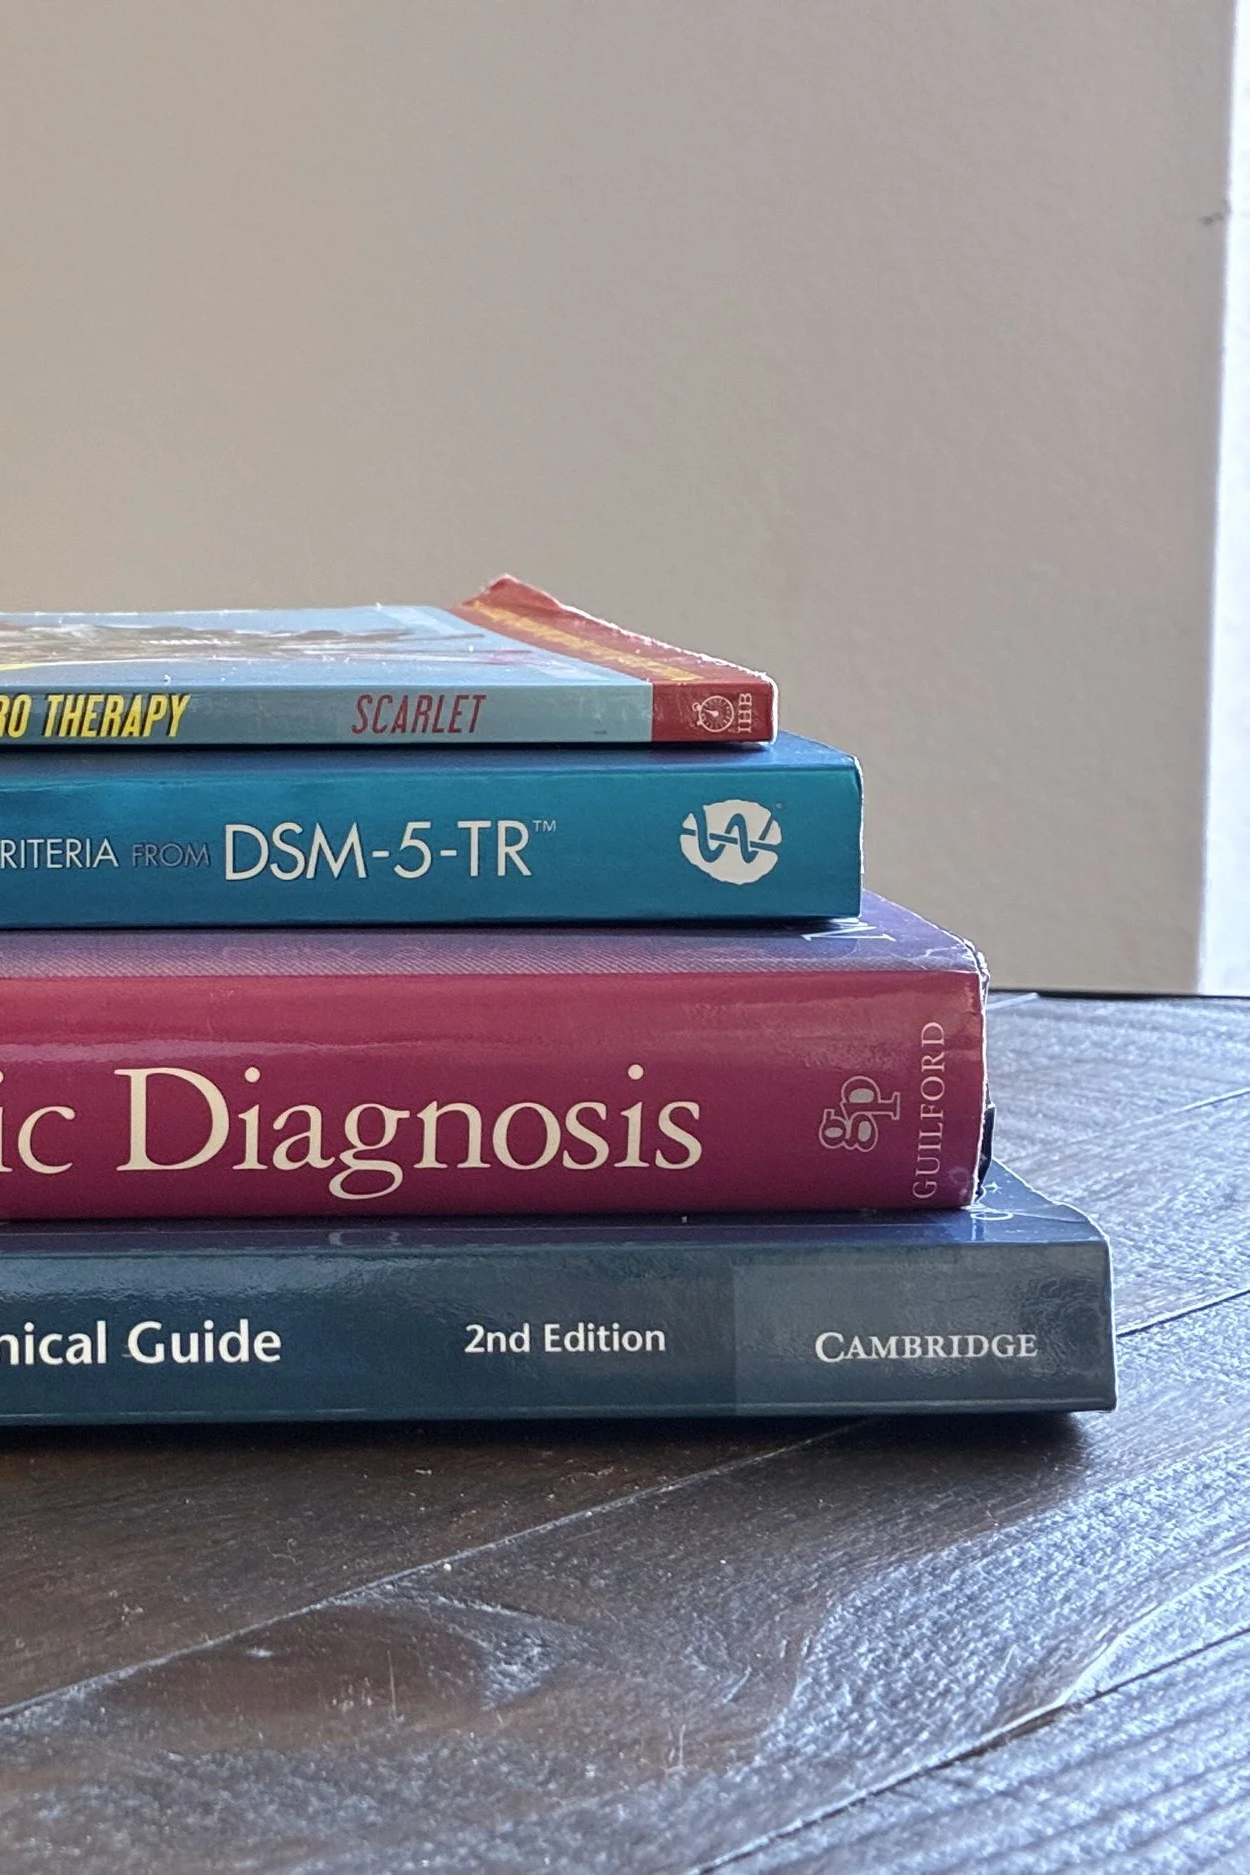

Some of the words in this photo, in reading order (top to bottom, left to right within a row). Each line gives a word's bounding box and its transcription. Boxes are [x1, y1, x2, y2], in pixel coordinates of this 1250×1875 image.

[42, 693, 191, 738] THERAPY
[352, 694, 486, 734] SCARLET
[132, 842, 211, 868] FROM
[114, 1064, 703, 1199] Diagnosis
[912, 1021, 946, 1198] GUILFORD
[127, 1319, 282, 1366] Guide
[464, 1324, 530, 1353] 2nd
[544, 1322, 666, 1352] Edition
